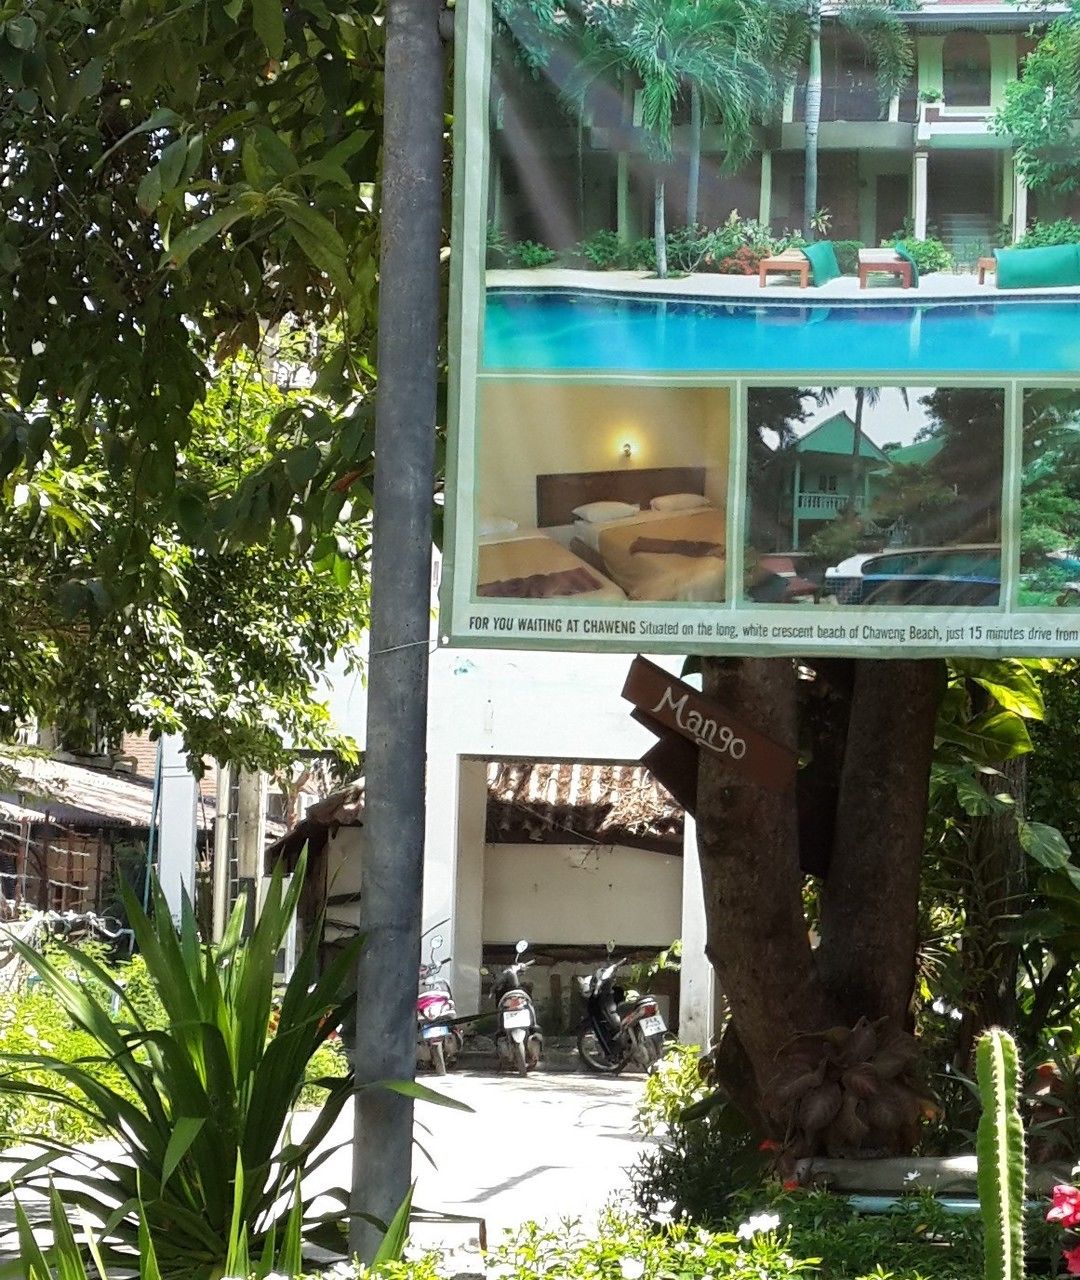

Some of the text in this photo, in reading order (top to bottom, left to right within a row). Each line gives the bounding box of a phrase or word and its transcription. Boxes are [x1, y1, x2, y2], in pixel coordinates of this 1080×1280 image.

[469, 617, 488, 630] FOR
[493, 617, 513, 631] YOU
[517, 618, 562, 632] WAITING
[566, 619, 580, 633] AT
[583, 619, 636, 634] CHAWENG
[639, 621, 679, 635] Situated
[682, 625, 693, 635] on
[697, 622, 712, 635] the
[716, 622, 739, 639] long,
[742, 623, 768, 637] white
[771, 625, 813, 638] crescent
[817, 625, 846, 639] beach
[849, 625, 859, 639] of
[862, 625, 905, 642] Chaweng
[909, 625, 942, 640] Beach,
[945, 627, 964, 642] just
[969, 626, 982, 640] 15
[986, 626, 1025, 640] minutes
[1028, 627, 1051, 640] drive
[1055, 628, 1078, 641] from
[651, 686, 747, 761] Mango
